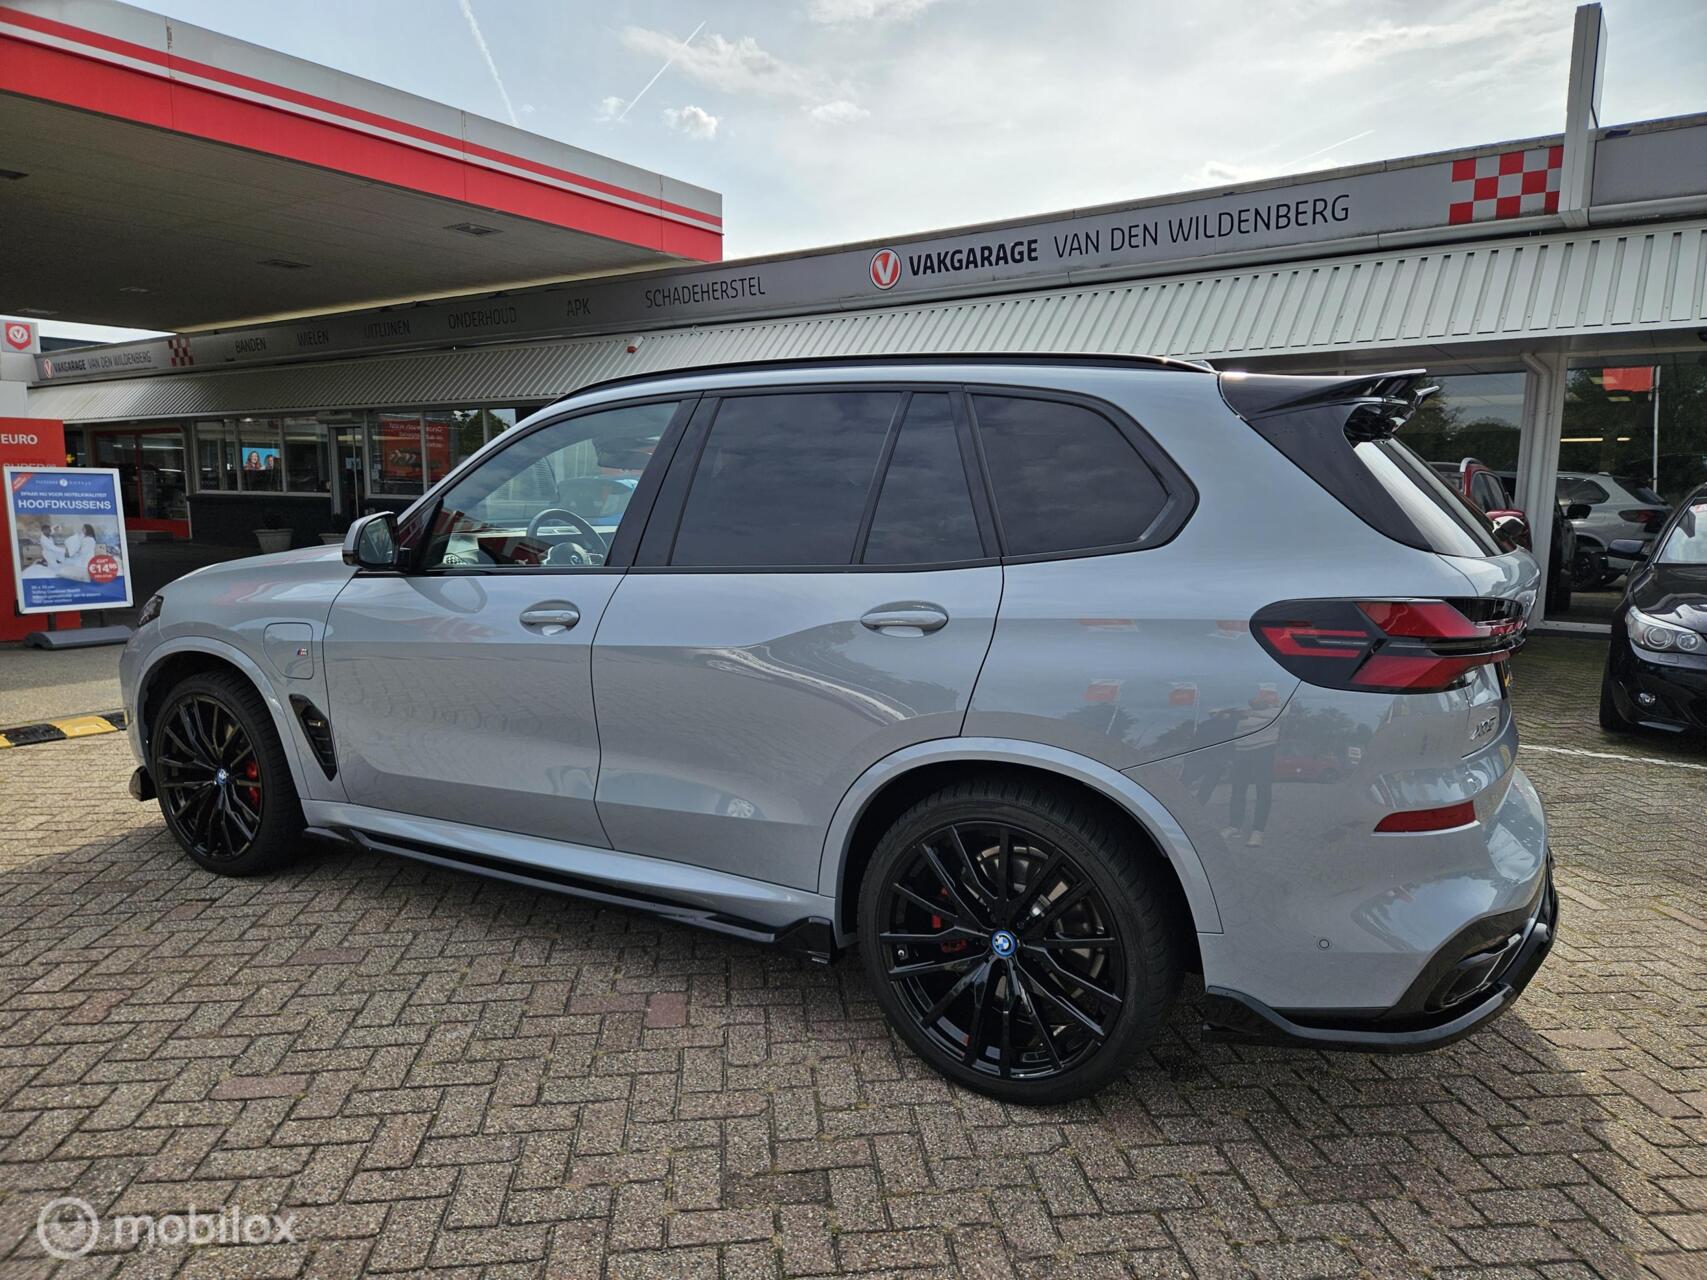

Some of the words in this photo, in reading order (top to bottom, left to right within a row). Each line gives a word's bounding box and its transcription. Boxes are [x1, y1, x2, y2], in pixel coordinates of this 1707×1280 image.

[908, 239, 1039, 276] VAKGARAGE
[1054, 230, 1100, 258] VAN
[1110, 221, 1158, 252] DEN
[1168, 194, 1350, 244] WILDENBERG
[645, 276, 766, 309] SCHADEHERSTEL
[566, 298, 592, 317] APK
[448, 307, 518, 330] ONDERHOUD
[296, 329, 329, 347] WIELEN
[363, 319, 411, 339] UITLIJNEN
[234, 337, 267, 354] BANDEN
[53, 359, 87, 374] VAKGARAGE
[88, 358, 100, 369] VAN
[100, 356, 113, 368] DEN
[114, 350, 152, 367] WILDENBERG
[1, 434, 38, 445] EURO
[18, 499, 112, 510] HOOFDKUSSENS
